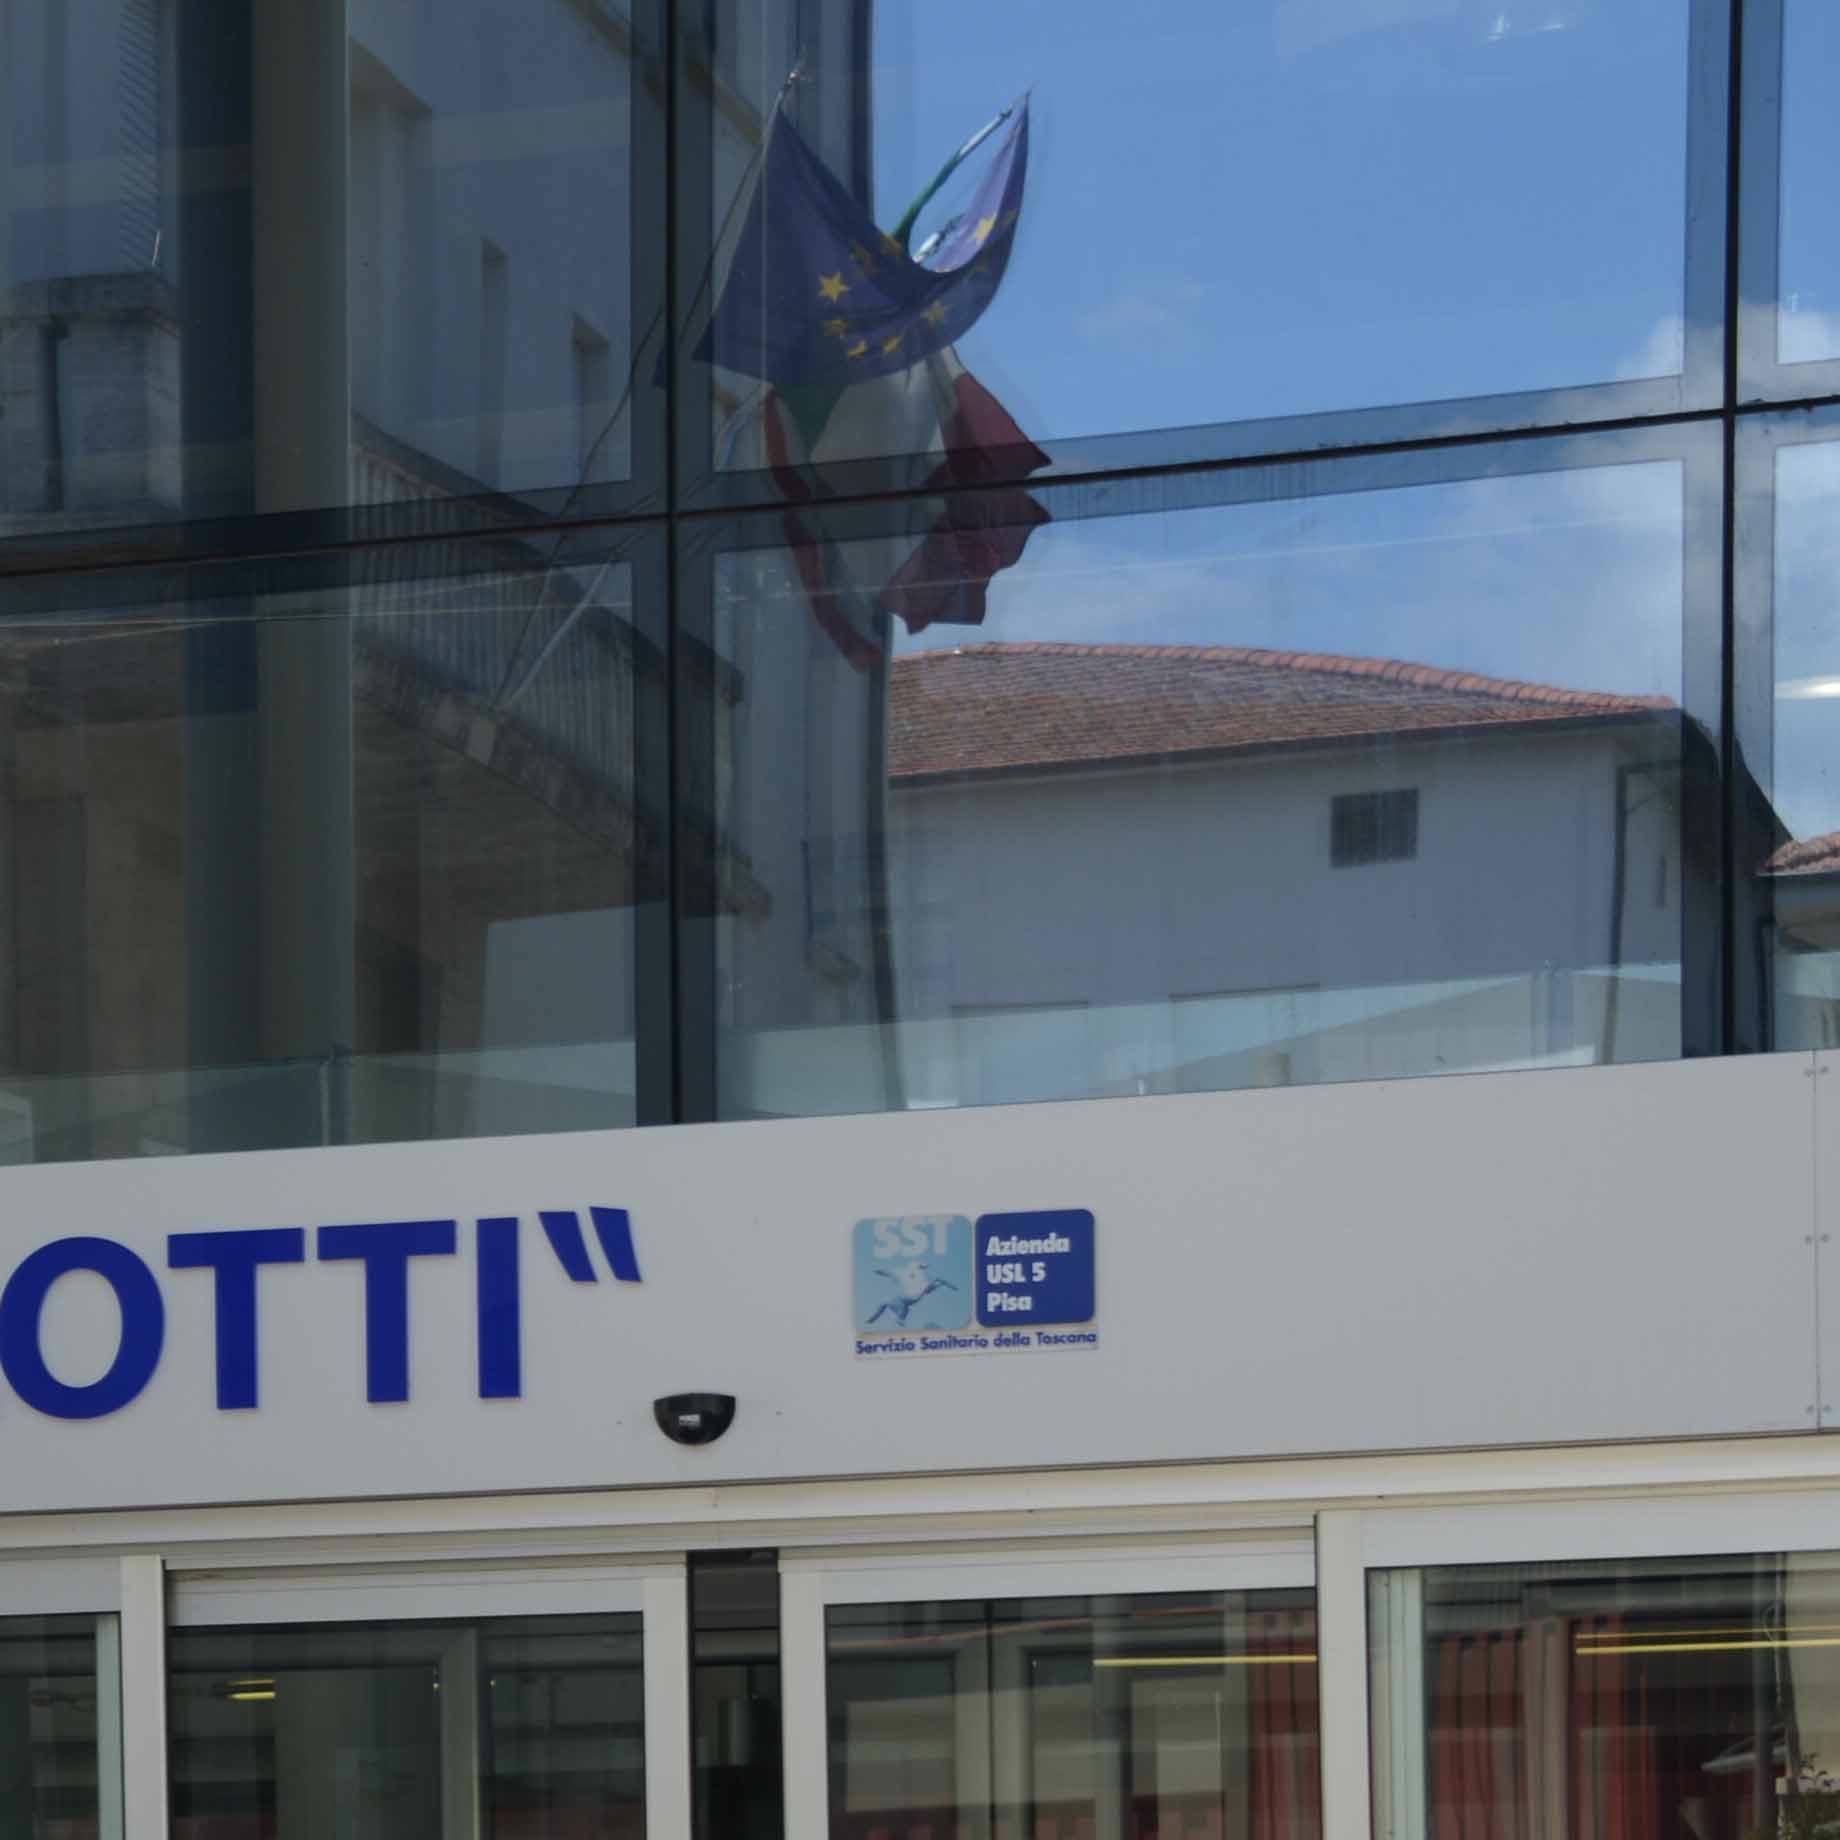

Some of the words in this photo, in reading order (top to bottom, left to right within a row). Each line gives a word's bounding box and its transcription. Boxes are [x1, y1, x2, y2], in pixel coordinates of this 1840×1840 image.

[872, 1215, 954, 1258] SST
[985, 1232, 1072, 1257] Azienda
[986, 1264, 1026, 1284] USL
[1031, 1262, 1047, 1282] 5
[986, 1292, 1034, 1313] Pisa
[856, 1338, 916, 1355] Servizio
[920, 1335, 989, 1351] Sanitario
[993, 1332, 1031, 1348] della
[1034, 1331, 1098, 1345] Toscana
